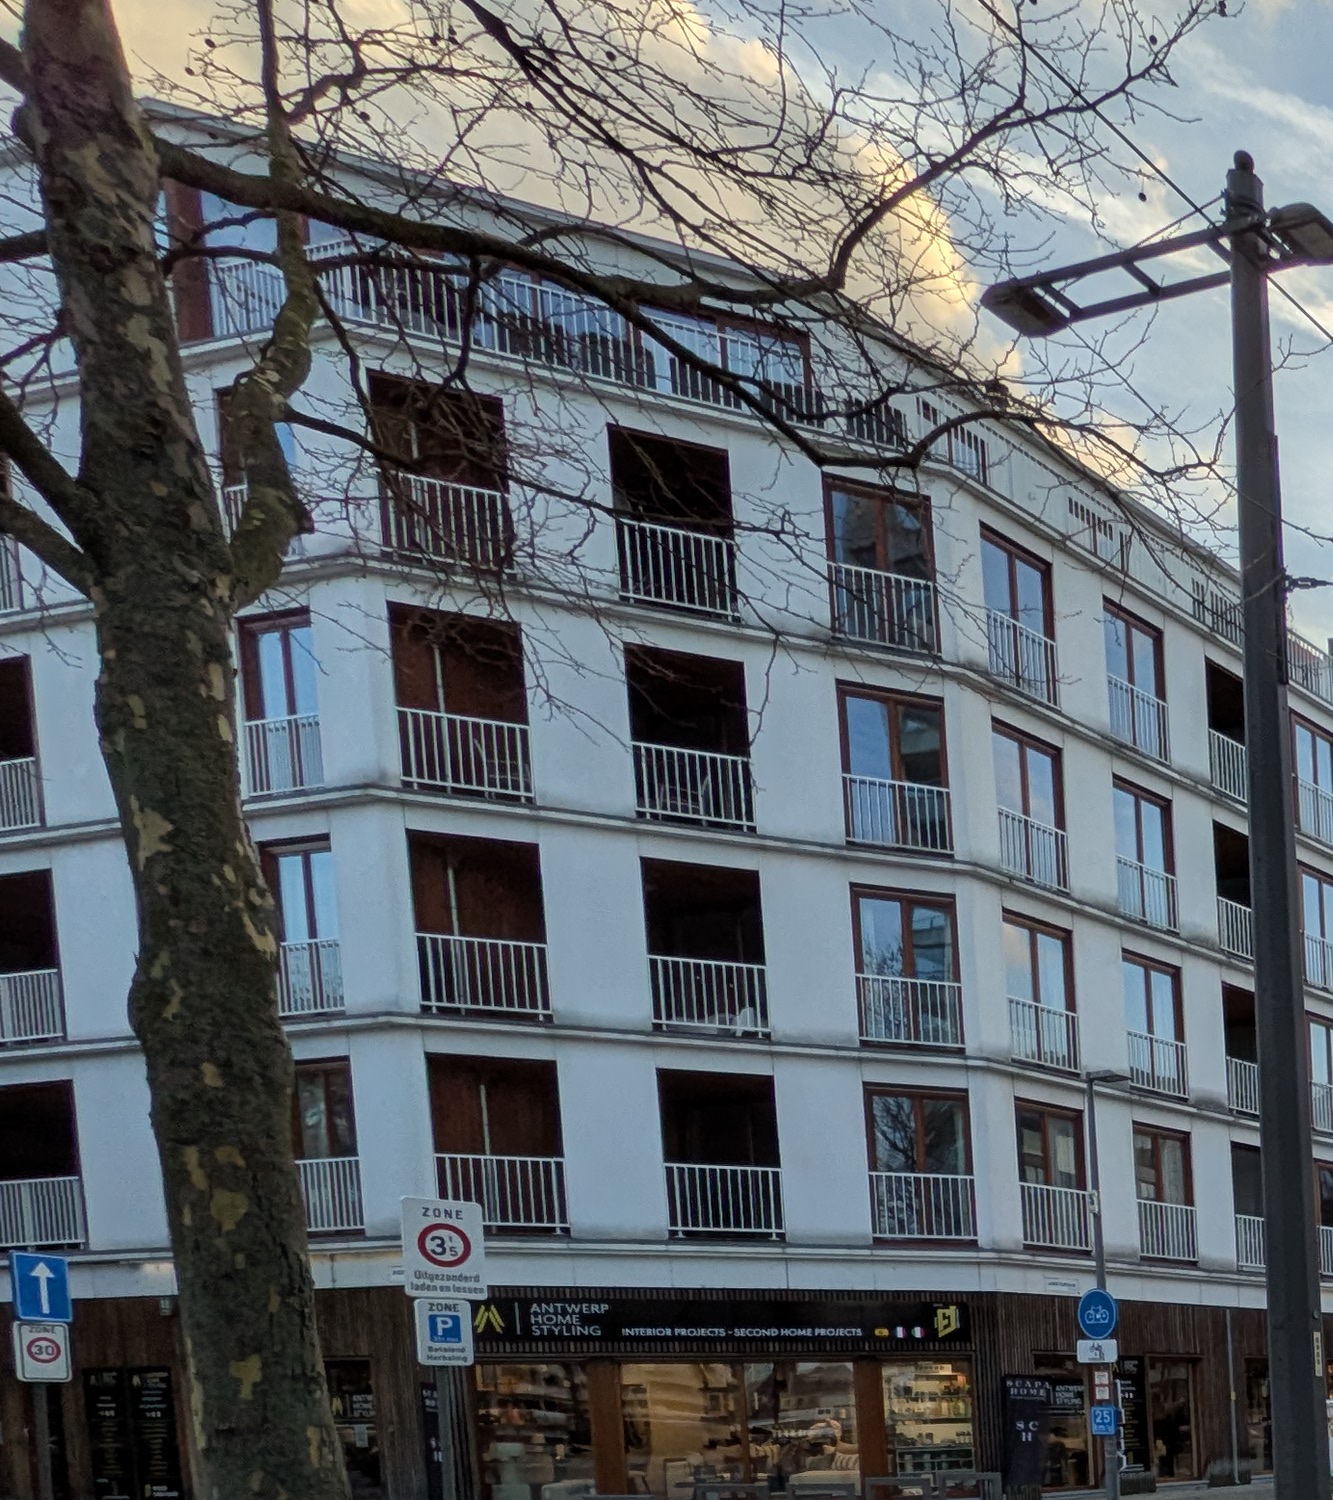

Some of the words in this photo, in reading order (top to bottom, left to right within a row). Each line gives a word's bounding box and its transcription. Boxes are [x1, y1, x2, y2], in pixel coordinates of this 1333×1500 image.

[422, 1206, 464, 1220] ZONE
[414, 1269, 480, 1284] Uitgezonderd
[410, 1281, 438, 1293] laden
[439, 1284, 452, 1293] en
[453, 1284, 485, 1295] lossen
[428, 1302, 460, 1313] ZONE
[530, 1302, 610, 1314] ANTWERP
[530, 1314, 582, 1325] HOME
[531, 1325, 602, 1337] STYLING
[621, 1328, 673, 1337] INTERIOR
[674, 1328, 727, 1337] PROJECTS
[733, 1328, 779, 1337] SECOND
[780, 1328, 813, 1337] HOME
[814, 1328, 863, 1337] PROJECTS
[34, 1344, 55, 1356] 30
[1010, 1388, 1047, 1397] HOME
[1094, 1410, 1111, 1423] 25
